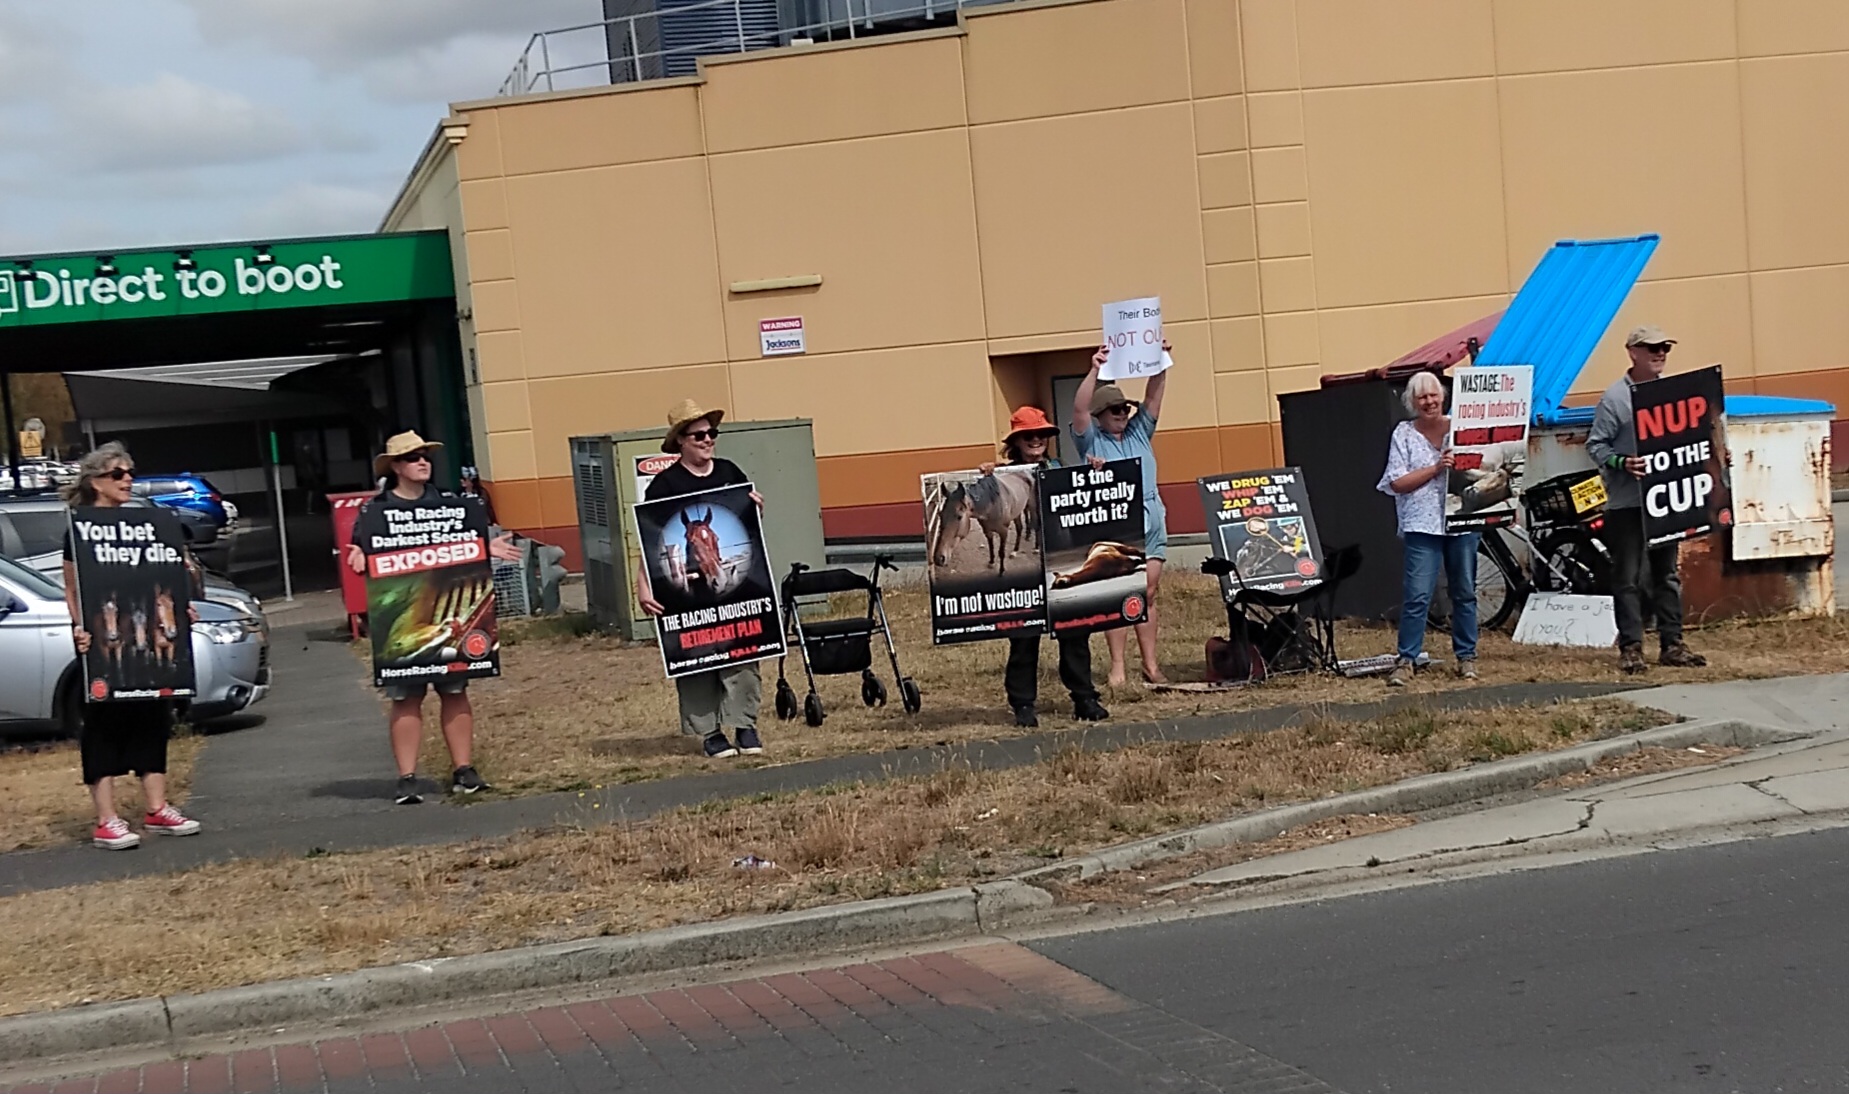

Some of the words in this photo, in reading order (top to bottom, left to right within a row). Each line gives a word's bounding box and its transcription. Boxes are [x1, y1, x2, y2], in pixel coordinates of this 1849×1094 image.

[24, 267, 167, 309] Direct
[175, 270, 227, 299] to
[234, 255, 344, 296] boot
[762, 320, 802, 330] WARNING
[1118, 310, 1140, 321] Their
[1108, 331, 1137, 348] NOT
[1143, 327, 1161, 344] OU
[1458, 401, 1485, 420] racing
[1487, 399, 1527, 420] industry's
[1636, 396, 1708, 441] NUP
[1642, 450, 1671, 474] TO
[1673, 440, 1711, 467] THE
[1071, 471, 1086, 488] Is
[1087, 469, 1115, 485] the
[1206, 482, 1230, 492] WE
[1231, 476, 1271, 489] DRUG
[1272, 474, 1295, 484] 'EM
[1050, 489, 1092, 513] party
[1094, 481, 1136, 503] really
[1222, 488, 1259, 499] WHIP
[1261, 485, 1284, 494] 'EM
[1222, 497, 1252, 510] ZAP
[1253, 495, 1275, 505] 'EM
[1278, 493, 1289, 504] &
[1646, 472, 1714, 518] CUP
[384, 509, 414, 522] The
[415, 506, 466, 520] Racing
[1060, 506, 1109, 528] worth
[1110, 502, 1129, 521] it?
[1217, 508, 1242, 521] WE
[1242, 504, 1274, 517] DOG
[1275, 503, 1298, 512] 'EM
[76, 521, 118, 541] You
[119, 521, 156, 541] bet
[389, 519, 464, 535] Industry's
[371, 533, 430, 549] Darkest
[431, 529, 479, 544] Secret
[95, 543, 142, 566] they
[145, 543, 182, 562] die.
[375, 542, 481, 574] EXPOSED
[936, 595, 959, 617] I'm
[960, 592, 982, 614] not
[984, 584, 1045, 611] wastage!
[1545, 599, 1574, 612] have
[661, 614, 682, 632] THE
[681, 607, 718, 629] RACING
[718, 597, 773, 621] INDUSTRY'S
[679, 623, 736, 650] RETIREMENT
[737, 618, 763, 639] PLAN
